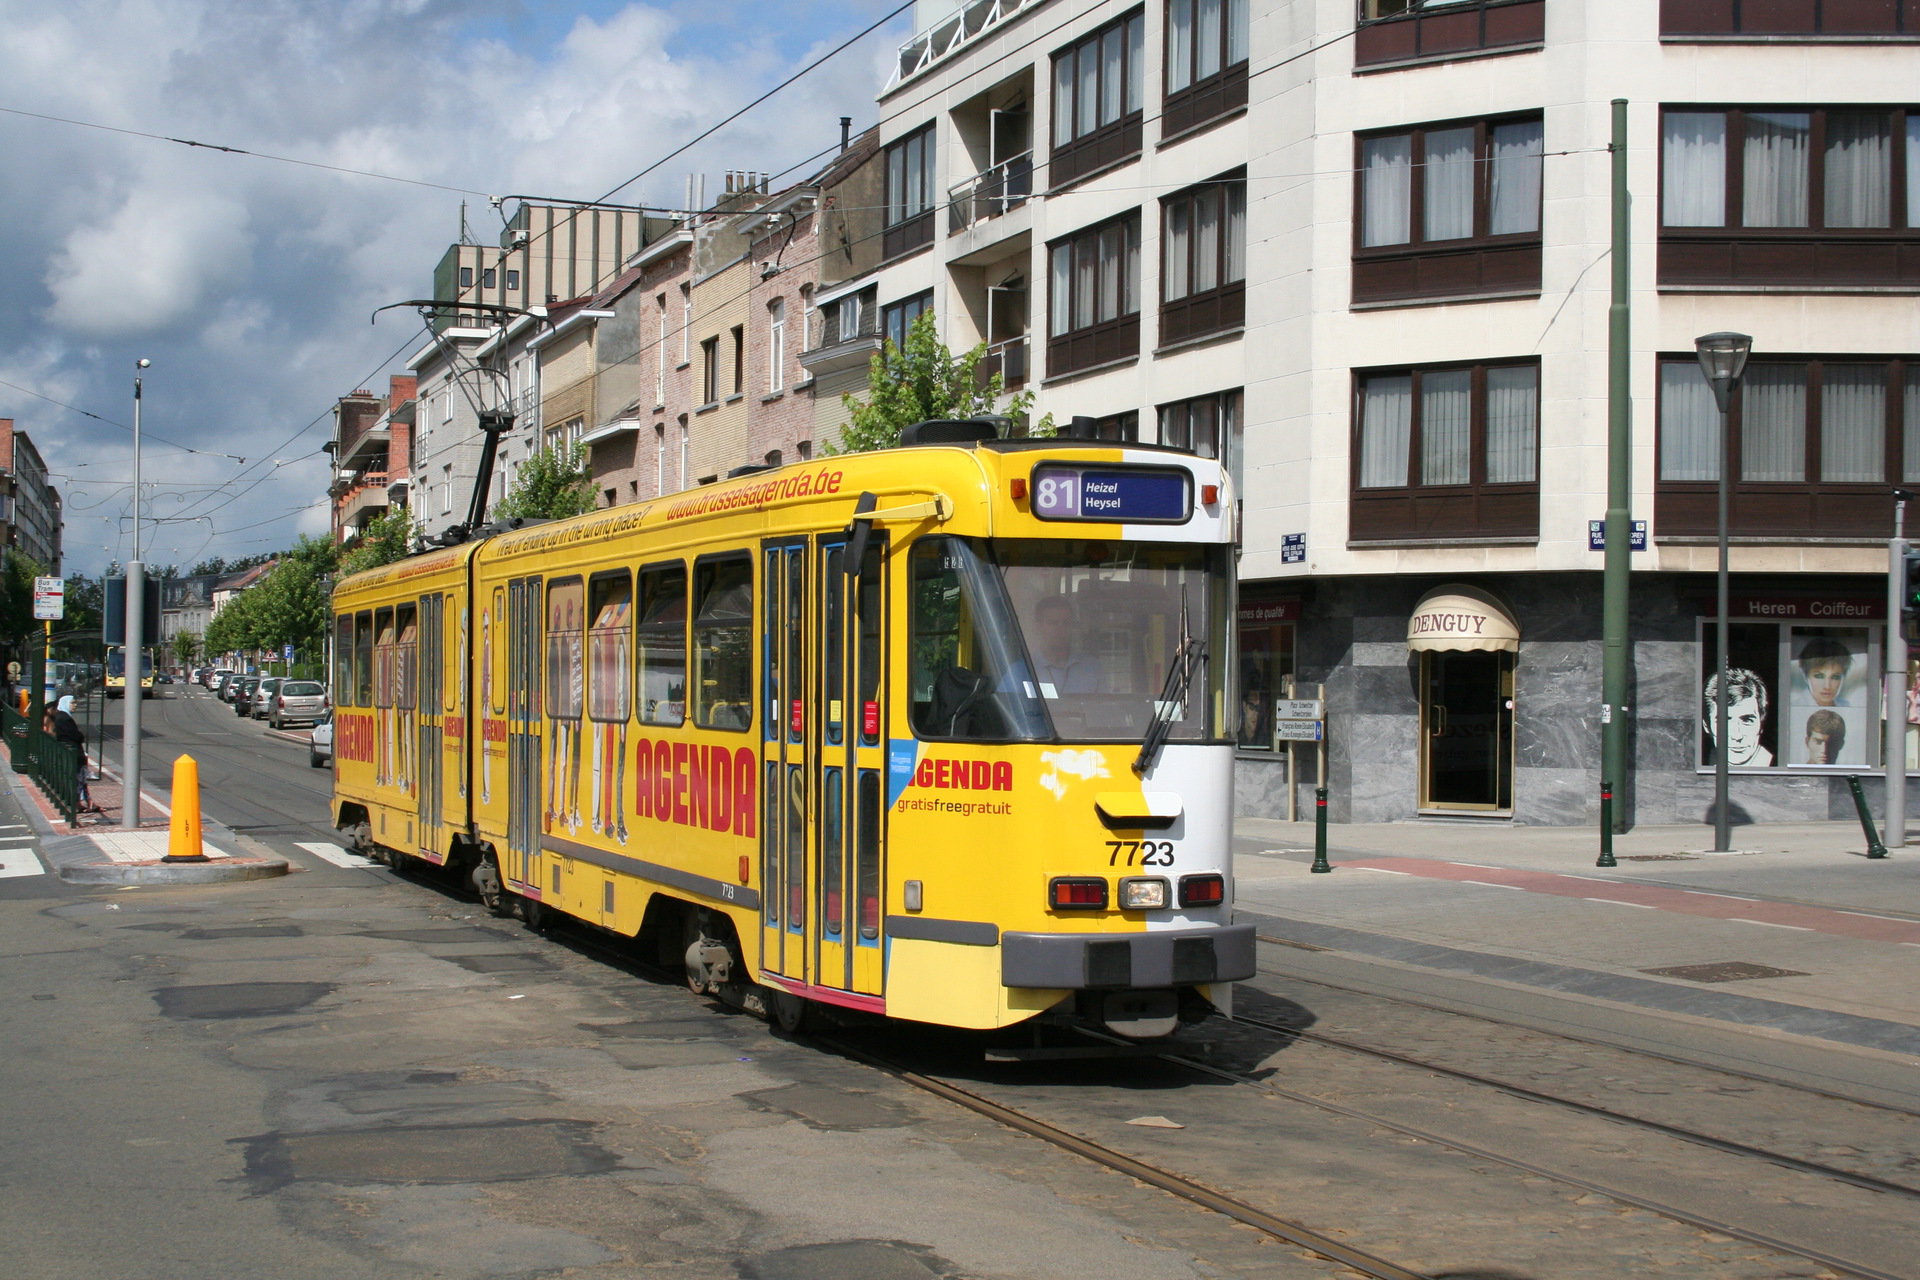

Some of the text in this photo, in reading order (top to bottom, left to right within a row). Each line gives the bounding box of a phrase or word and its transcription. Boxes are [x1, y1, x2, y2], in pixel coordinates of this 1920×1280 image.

[667, 467, 843, 520] www.brusselsagenda.be
[1038, 478, 1073, 509] 81
[1086, 482, 1118, 494] Heizel
[1085, 497, 1121, 510] Heysel
[568, 523, 585, 542] the
[584, 518, 614, 541] wrong
[612, 505, 652, 540] place?
[1255, 607, 1264, 619] de
[1264, 605, 1286, 621] qualité
[1750, 601, 1871, 616] Heren Coiffeur
[1413, 614, 1486, 634] DENGUY
[338, 714, 374, 763] AGENDA
[908, 758, 1013, 791] GENDA
[636, 738, 756, 838] AGENDA
[897, 798, 1012, 817] gratisfreegratuit
[1105, 841, 1175, 867] 7723
